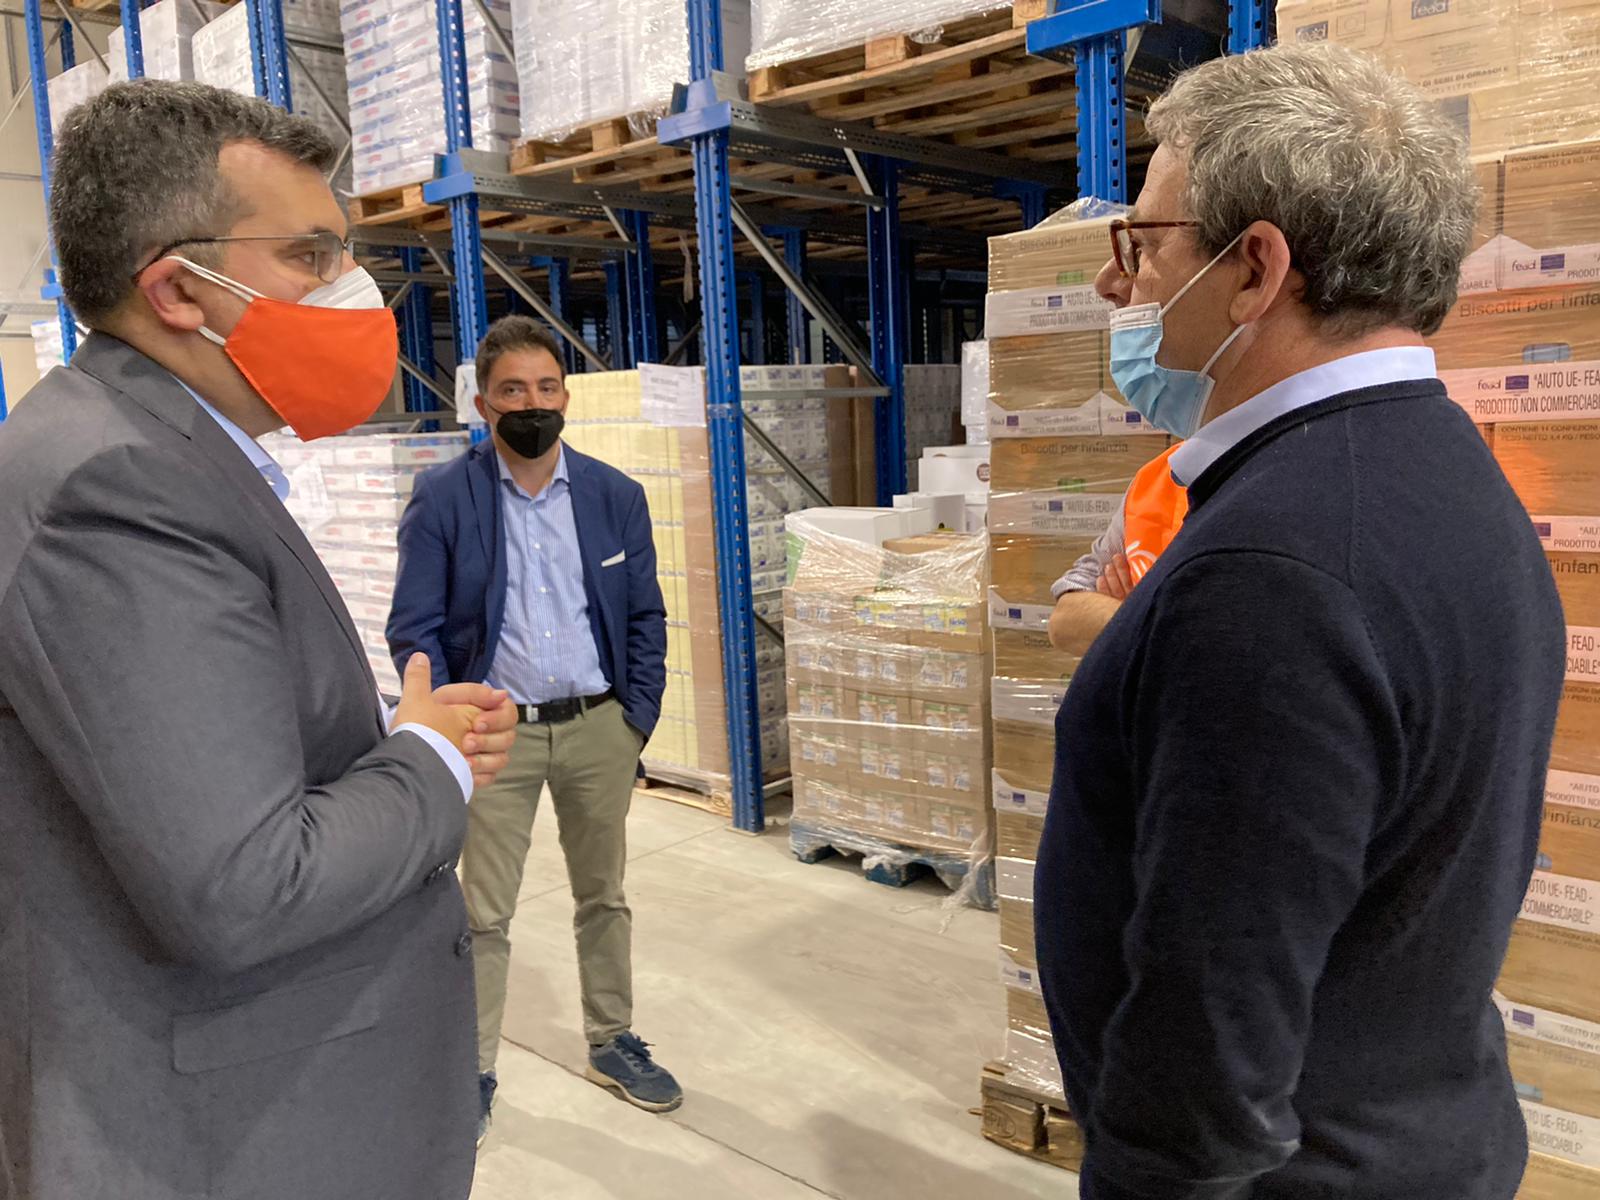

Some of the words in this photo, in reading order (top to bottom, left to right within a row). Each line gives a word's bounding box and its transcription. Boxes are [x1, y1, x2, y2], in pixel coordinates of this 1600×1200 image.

[1512, 260, 1536, 272] fead
[1460, 298, 1520, 318] Biscotti
[1526, 298, 1554, 314] per
[1477, 379, 1502, 390] fead
[1474, 396, 1518, 415] PRODOTTO
[1520, 396, 1538, 412] NON
[1553, 538, 1597, 549] PRODOTTO
[1571, 634, 1594, 652] FEAD
[1564, 884, 1588, 903] FEAD
[1556, 1116, 1578, 1135] FEAD
